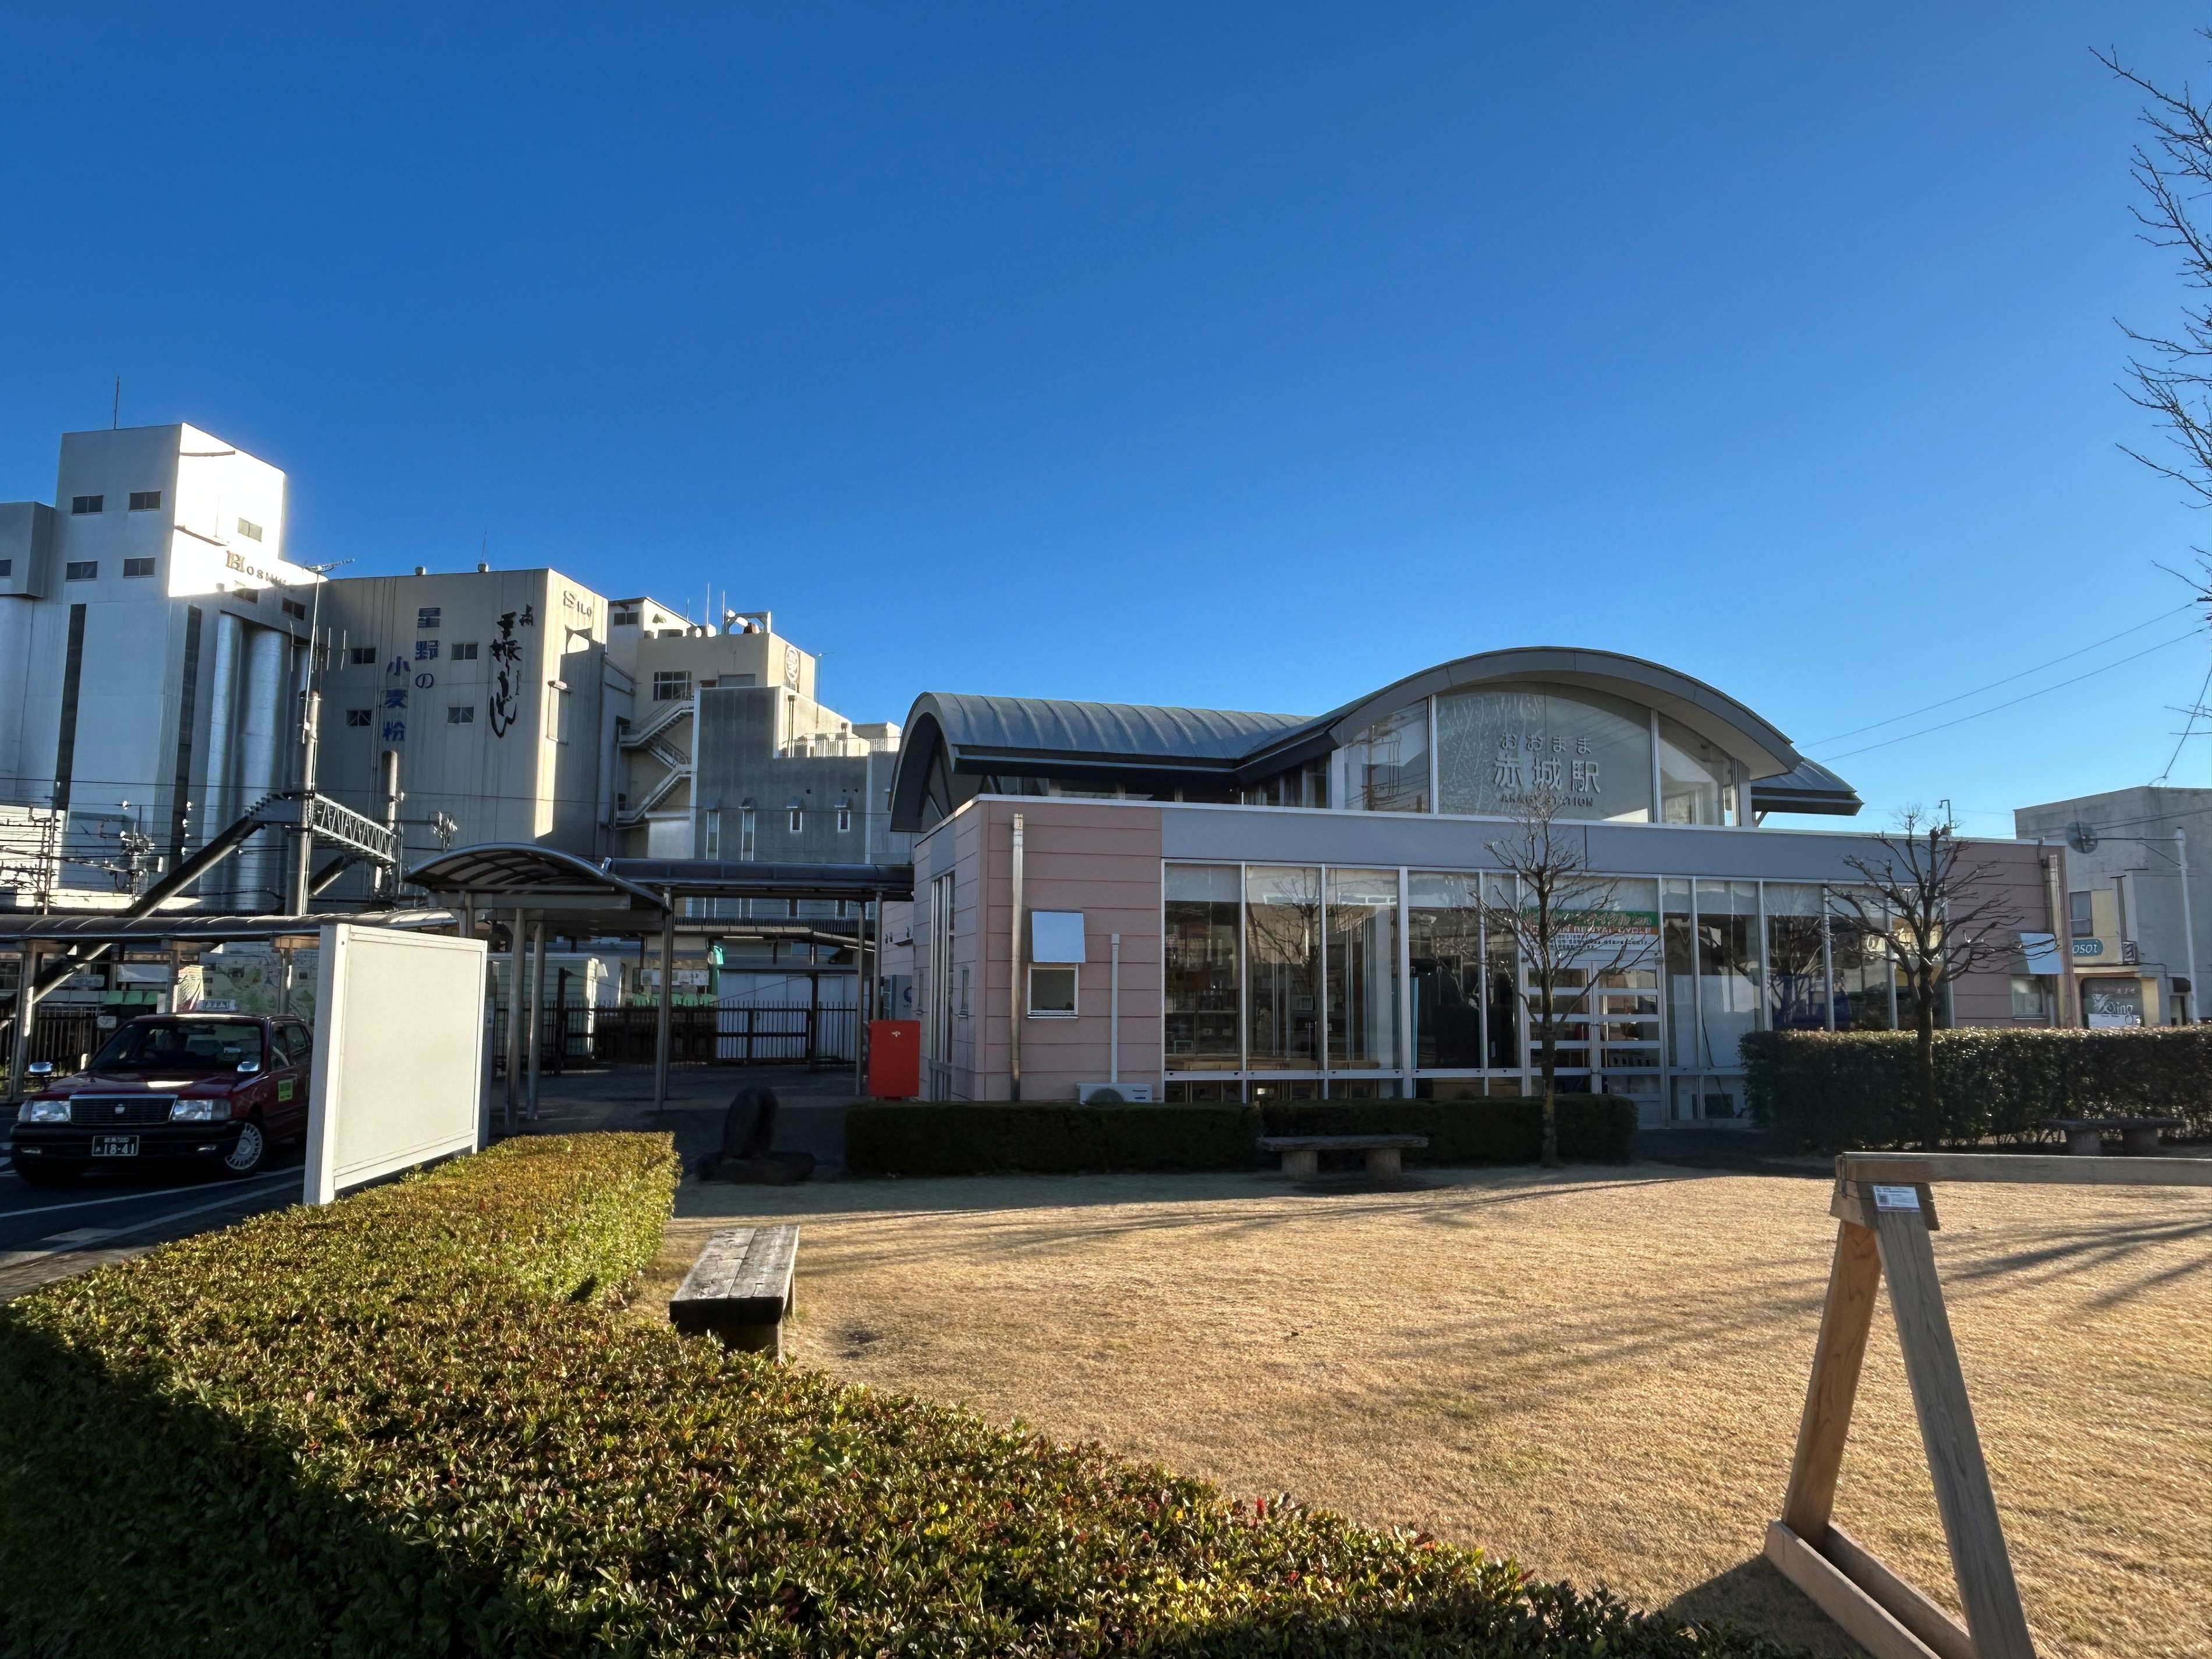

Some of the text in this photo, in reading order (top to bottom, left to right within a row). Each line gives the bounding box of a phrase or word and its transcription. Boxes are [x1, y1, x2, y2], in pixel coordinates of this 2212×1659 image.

[415, 607, 441, 689] 星野の
[382, 656, 411, 742] 小麦粉
[1501, 732, 1592, 755] おおまま
[1494, 755, 1601, 794] 赤城駅
